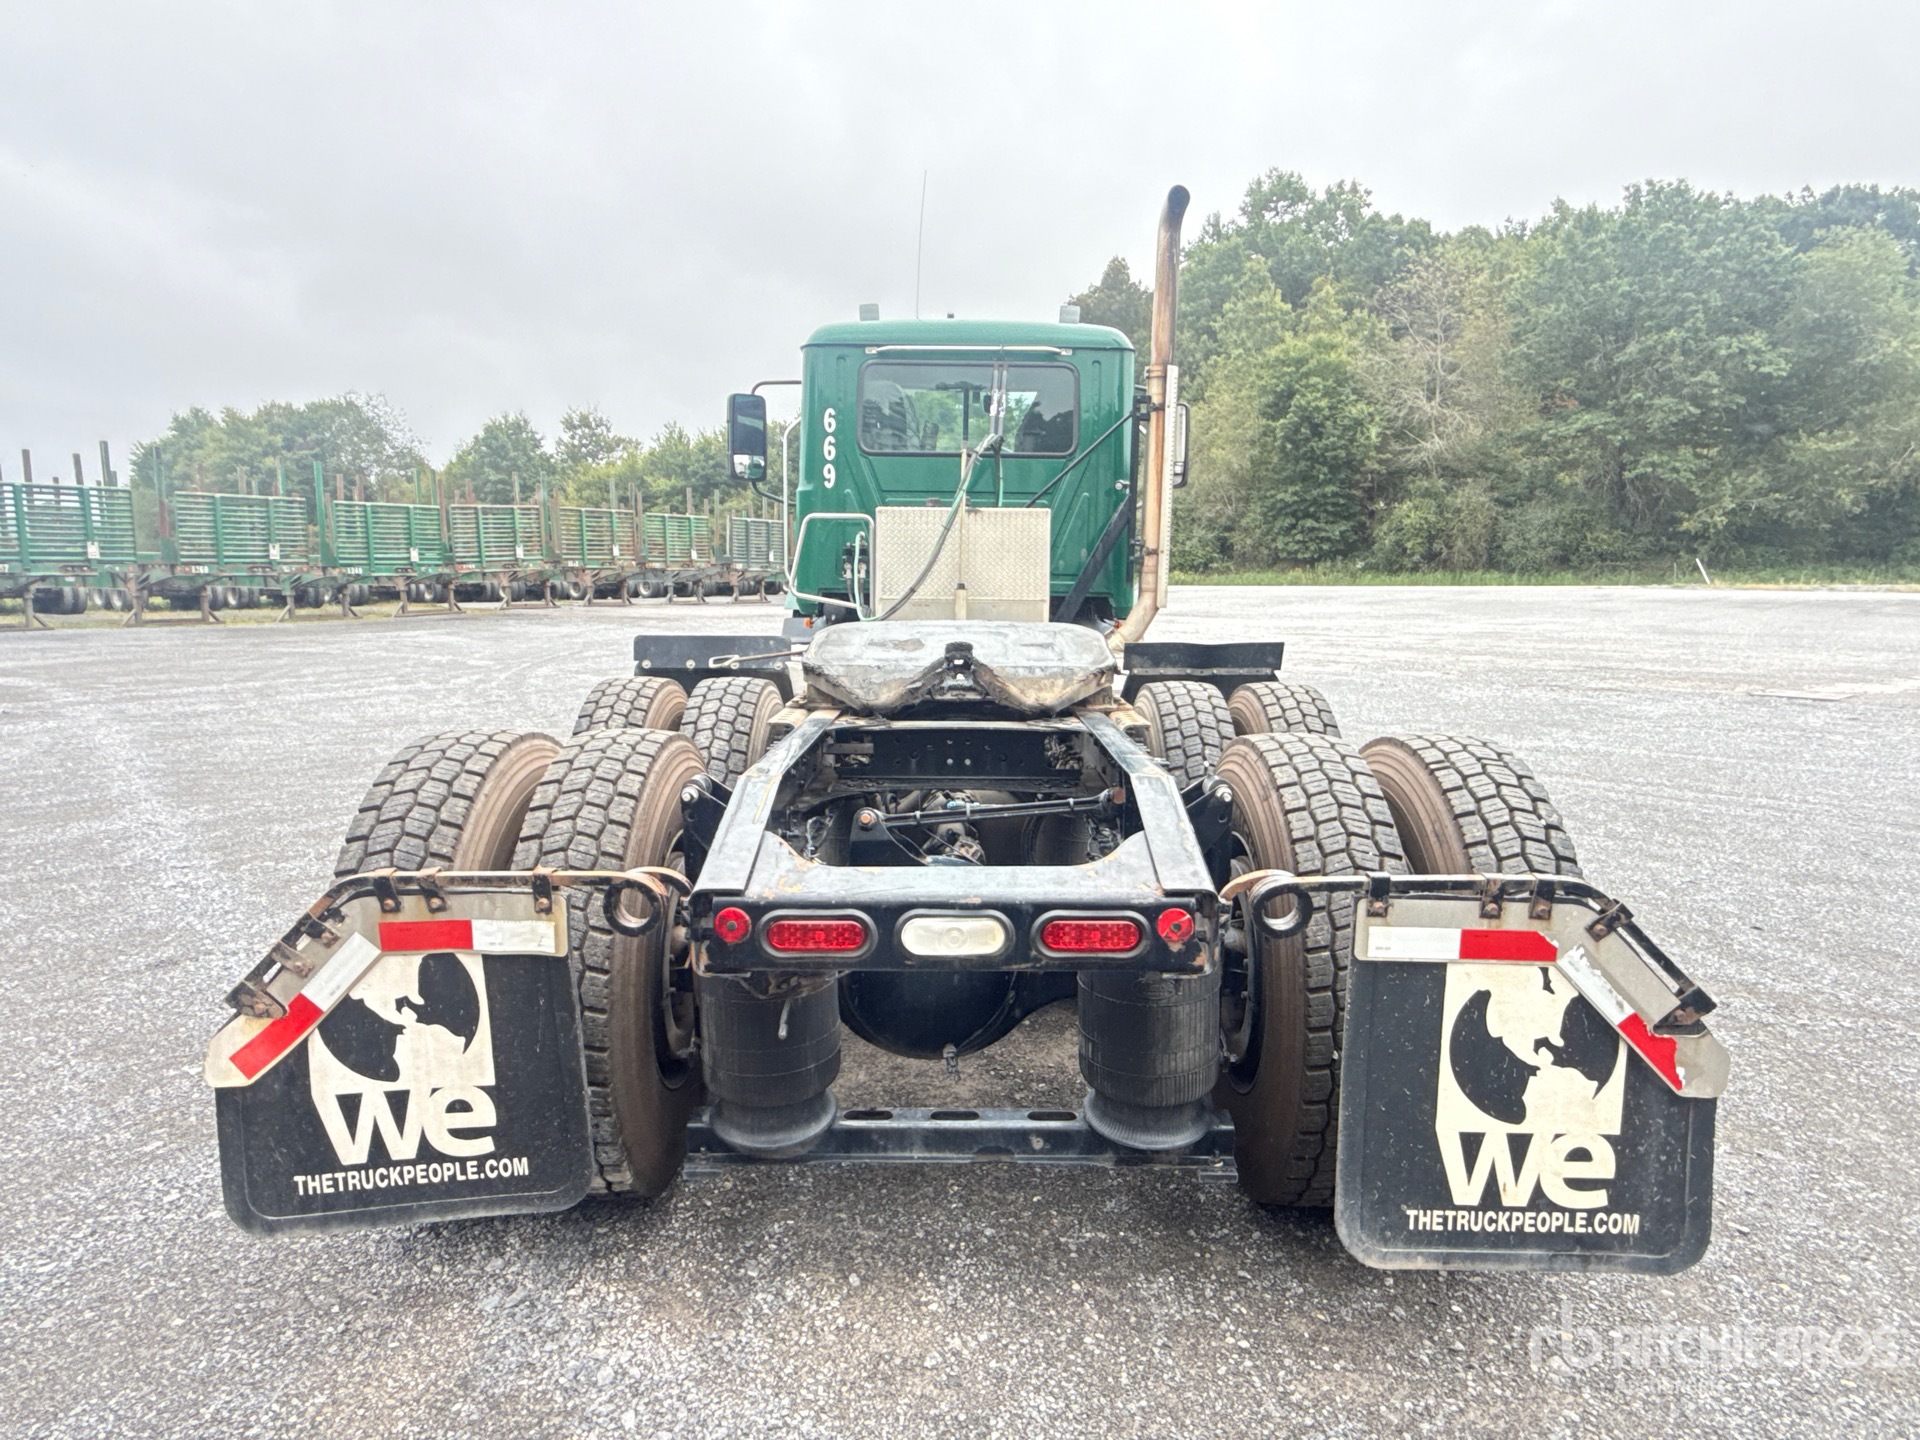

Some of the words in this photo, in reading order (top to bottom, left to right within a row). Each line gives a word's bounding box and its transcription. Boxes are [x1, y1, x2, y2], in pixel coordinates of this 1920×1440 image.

[823, 408, 836, 488] 669
[293, 1157, 529, 1195] THETRUCKPEOPLE.COM
[1406, 1210, 1640, 1235] THETRUCKPEOPLE.COM
